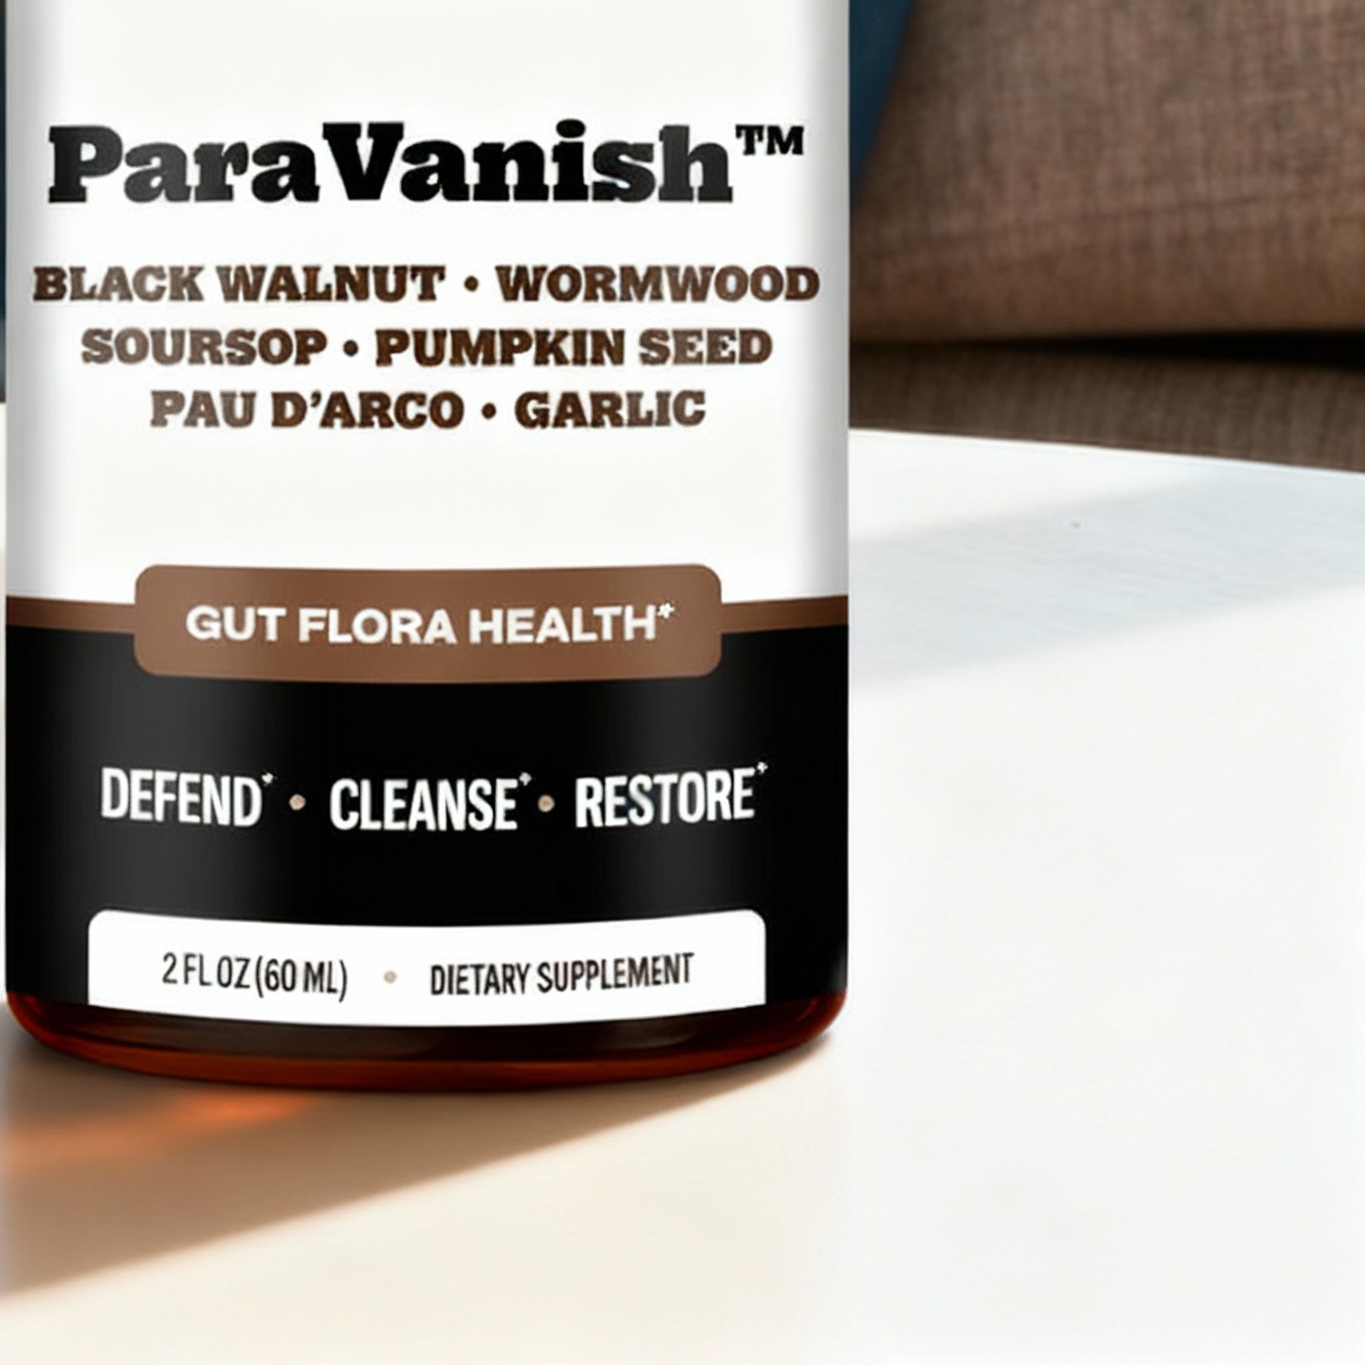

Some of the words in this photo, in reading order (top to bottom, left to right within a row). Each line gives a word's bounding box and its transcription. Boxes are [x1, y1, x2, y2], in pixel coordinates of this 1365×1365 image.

[32, 266, 205, 303] BLACK
[216, 265, 446, 303] WALNUT
[495, 265, 822, 303] WORMWOOD
[82, 328, 327, 366] SOURSOP
[375, 328, 625, 367] PUMPKIN
[639, 328, 773, 366] SEED
[151, 390, 257, 428] PAU
[271, 390, 464, 430] D’ARCO
[514, 390, 706, 429] GARLIC
[185, 605, 287, 642] GUT
[299, 607, 458, 644] FLORA
[162, 951, 178, 985] 2
[183, 952, 213, 987] FL
[302, 959, 348, 1003] ML)
[430, 963, 532, 996] DIETARY
[536, 952, 695, 994] SUPPLEMENT
